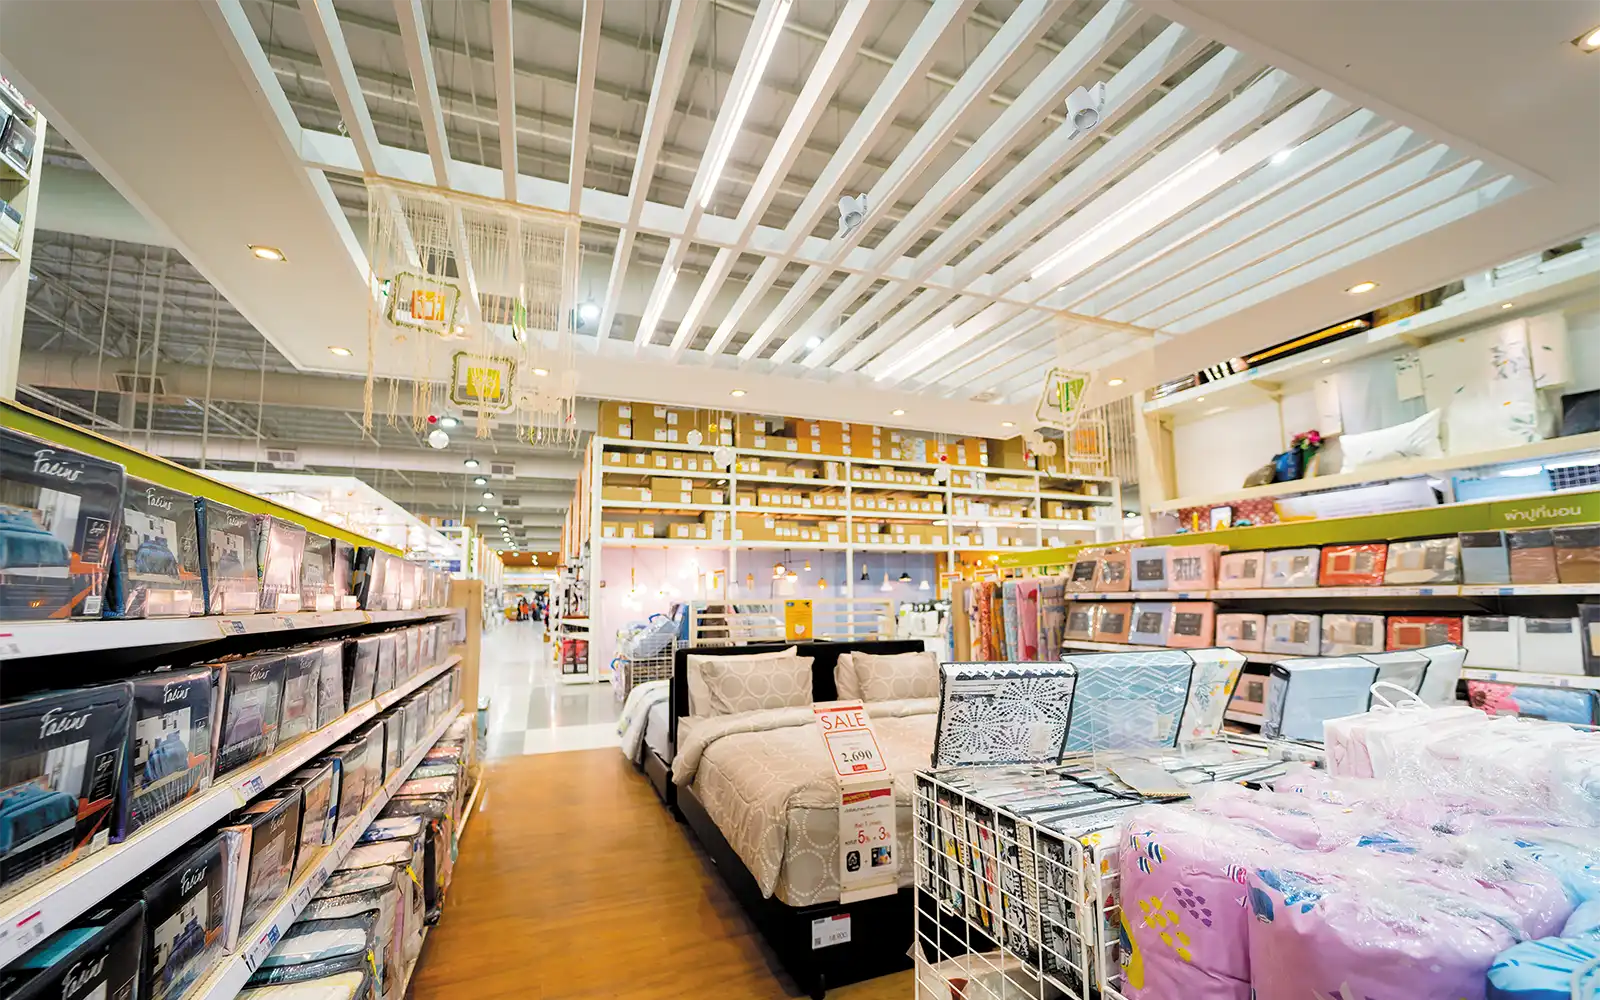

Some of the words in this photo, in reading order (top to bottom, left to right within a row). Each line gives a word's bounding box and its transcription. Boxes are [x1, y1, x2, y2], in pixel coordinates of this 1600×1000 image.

[1503, 504, 1582, 521] ผ้าปูที่นอน
[820, 712, 866, 730] SALE
[841, 750, 873, 763] 2,690
